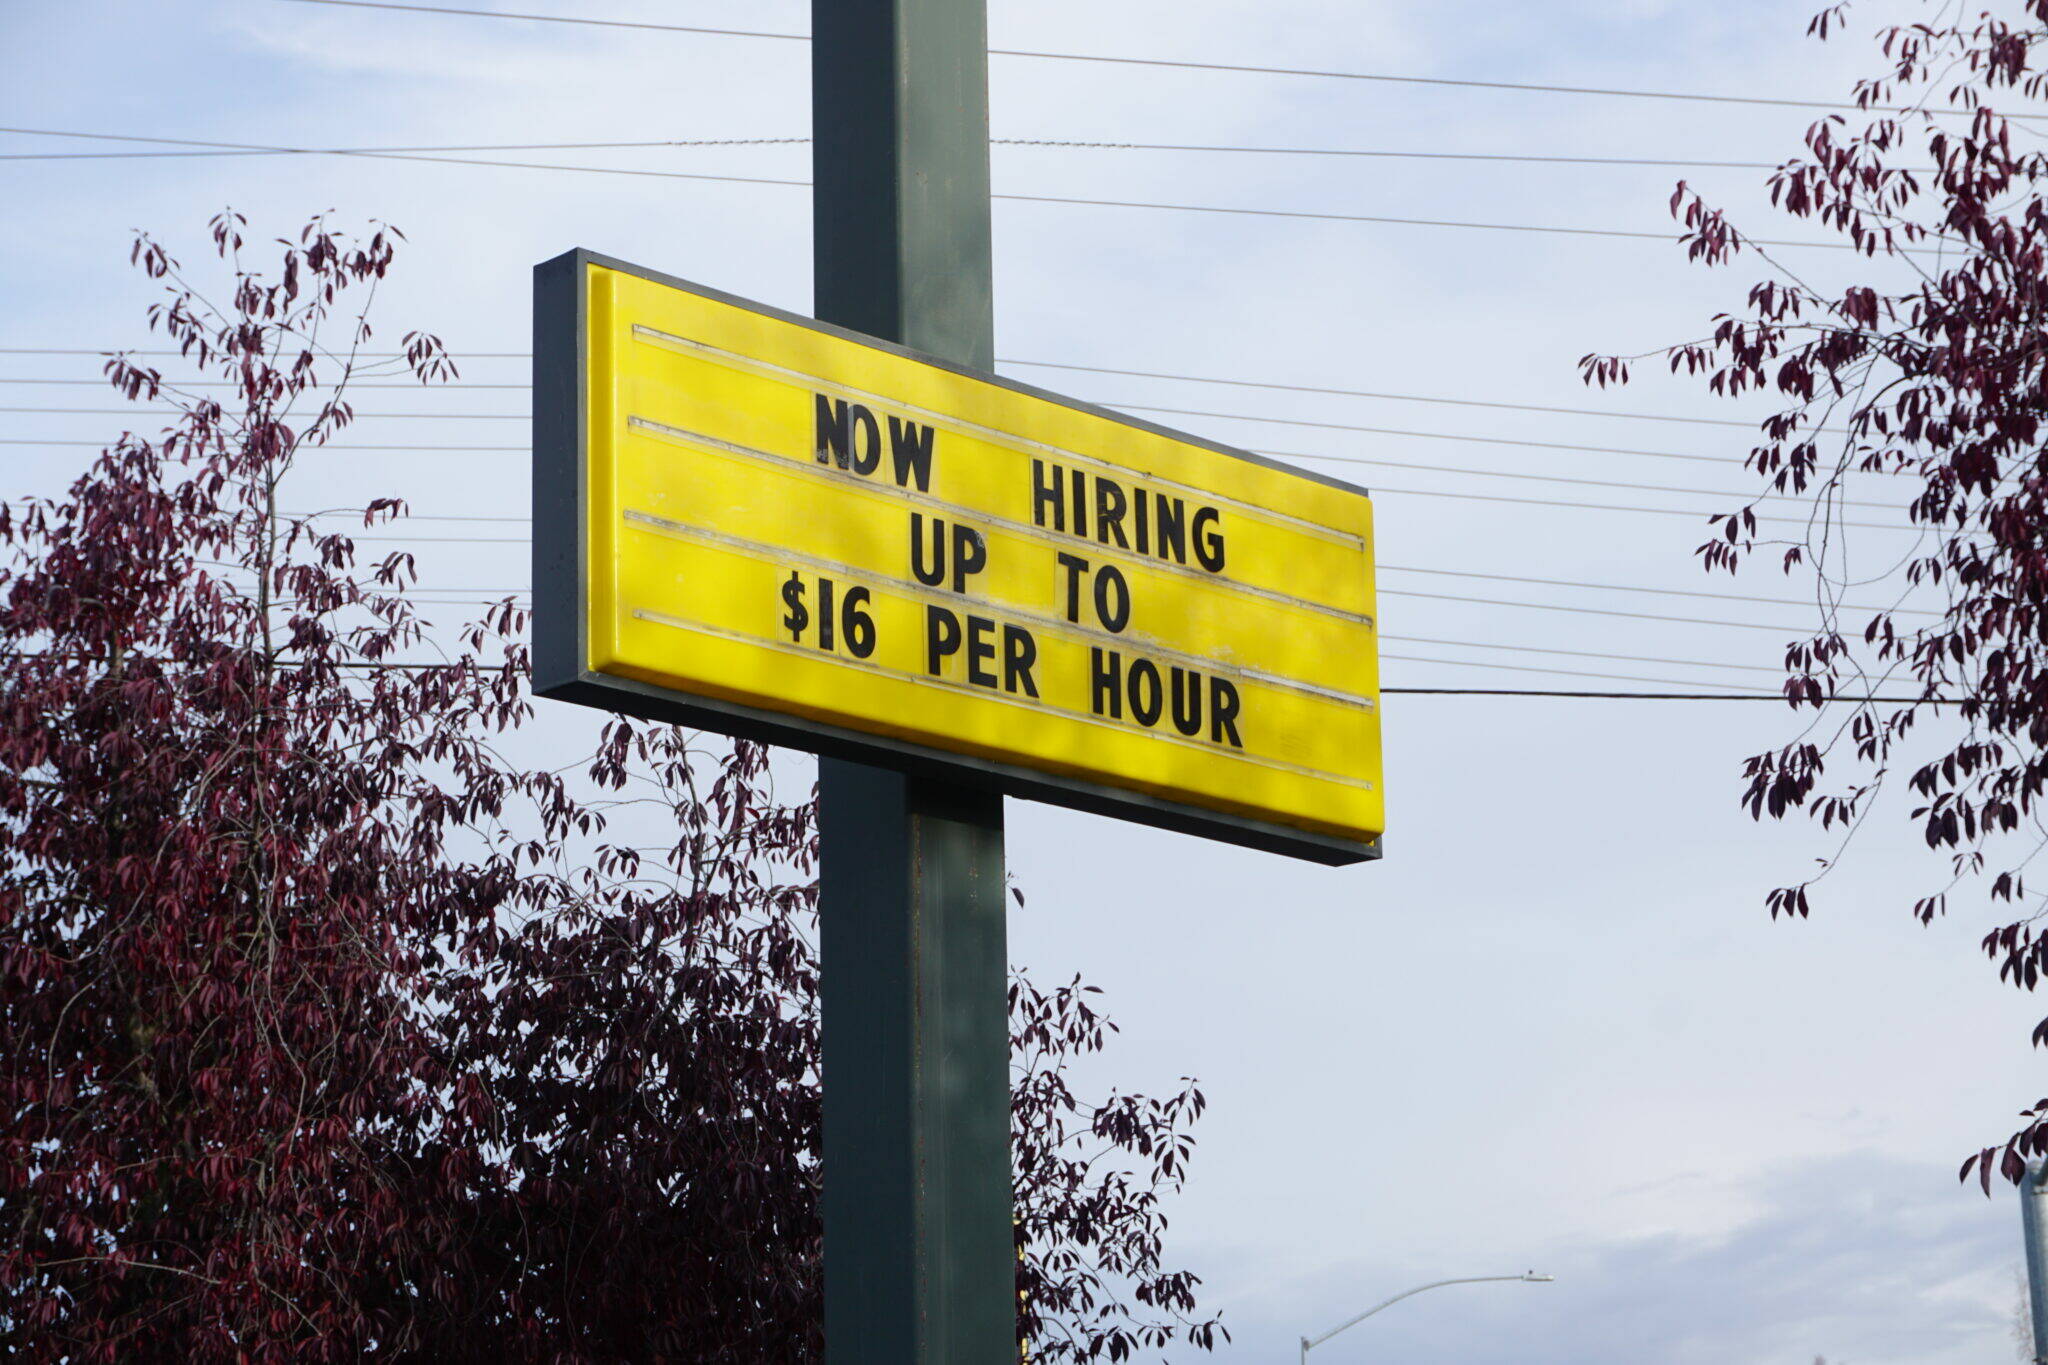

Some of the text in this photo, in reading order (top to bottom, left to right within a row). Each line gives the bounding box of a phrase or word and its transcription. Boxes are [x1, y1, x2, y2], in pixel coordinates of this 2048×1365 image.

[816, 394, 1225, 574] NOW HIRING
[911, 512, 1131, 634] UP TO
[782, 571, 1243, 749] $16 PER HOUR
